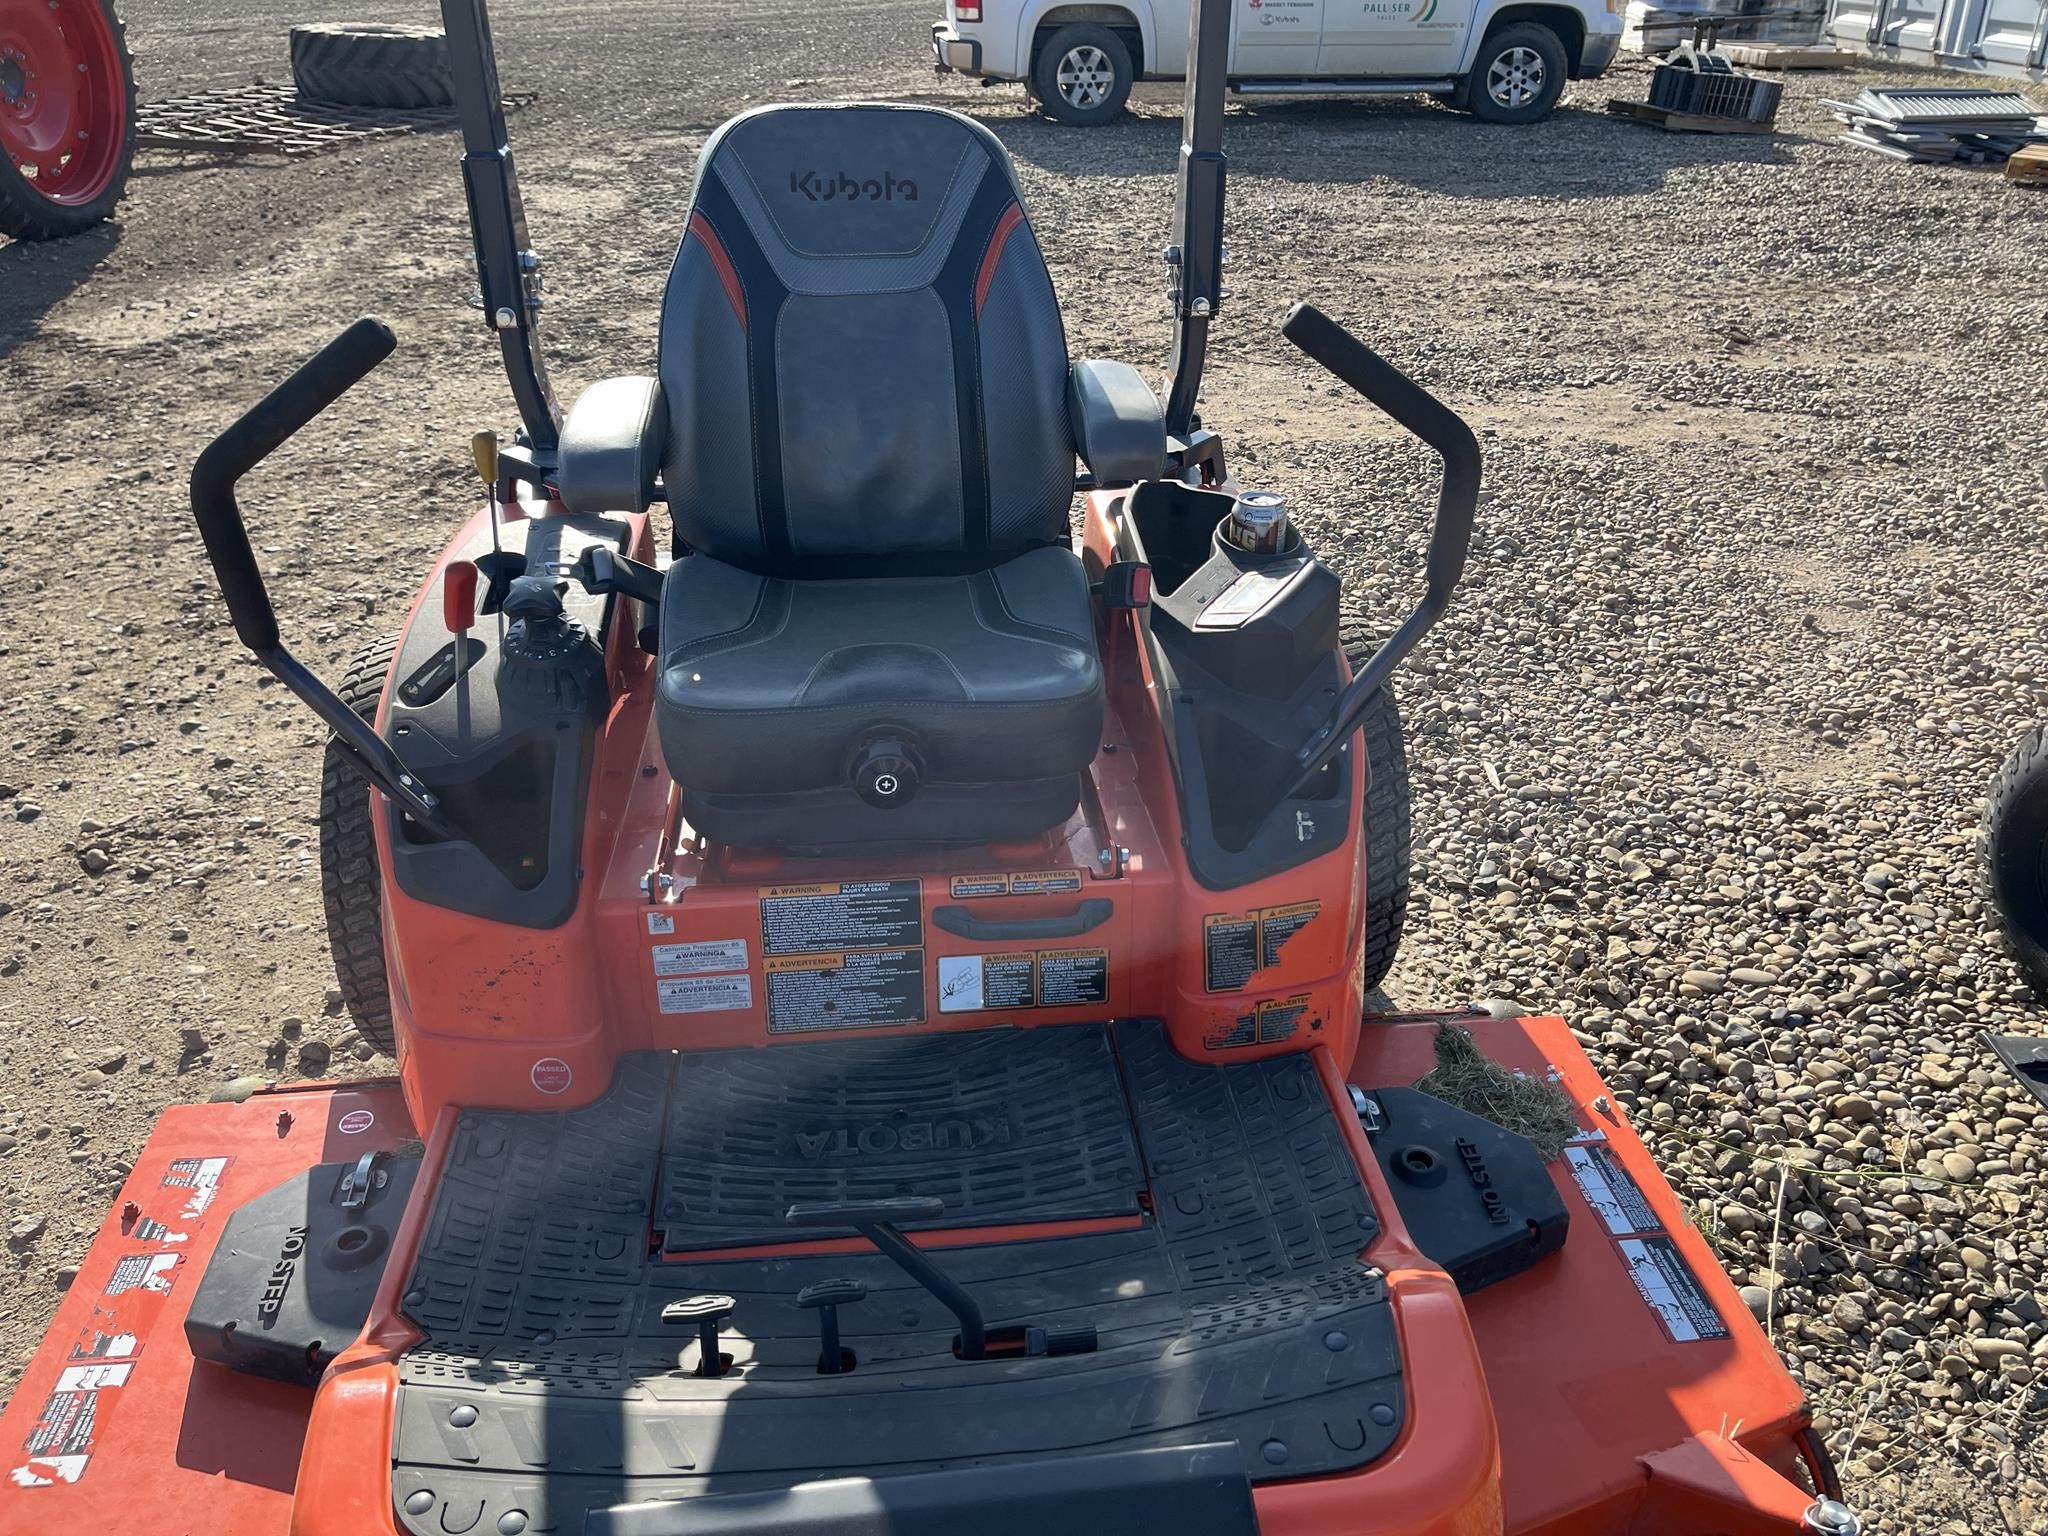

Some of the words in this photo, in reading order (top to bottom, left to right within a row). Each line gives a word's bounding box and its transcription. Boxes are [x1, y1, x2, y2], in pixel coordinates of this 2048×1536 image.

[790, 171, 918, 200] Kubota
[966, 875, 1003, 883] WARNING
[1023, 871, 1077, 880] ADVERTENCIA
[781, 887, 821, 895] WARNING
[682, 951, 720, 959] WARNING
[780, 958, 838, 968] ADVERTENCIA
[678, 985, 731, 994] ADVERTENCIA
[795, 1116, 1011, 1160] KUBOTA
[1456, 1136, 1490, 1184] STEP
[1572, 1173, 1592, 1204] PELIGRO
[1480, 1188, 1512, 1224] NO
[283, 1226, 307, 1255] NO
[262, 1259, 296, 1314] STEP
[1629, 1269, 1654, 1303] DANGER
[51, 1407, 79, 1446] PELIGRO
